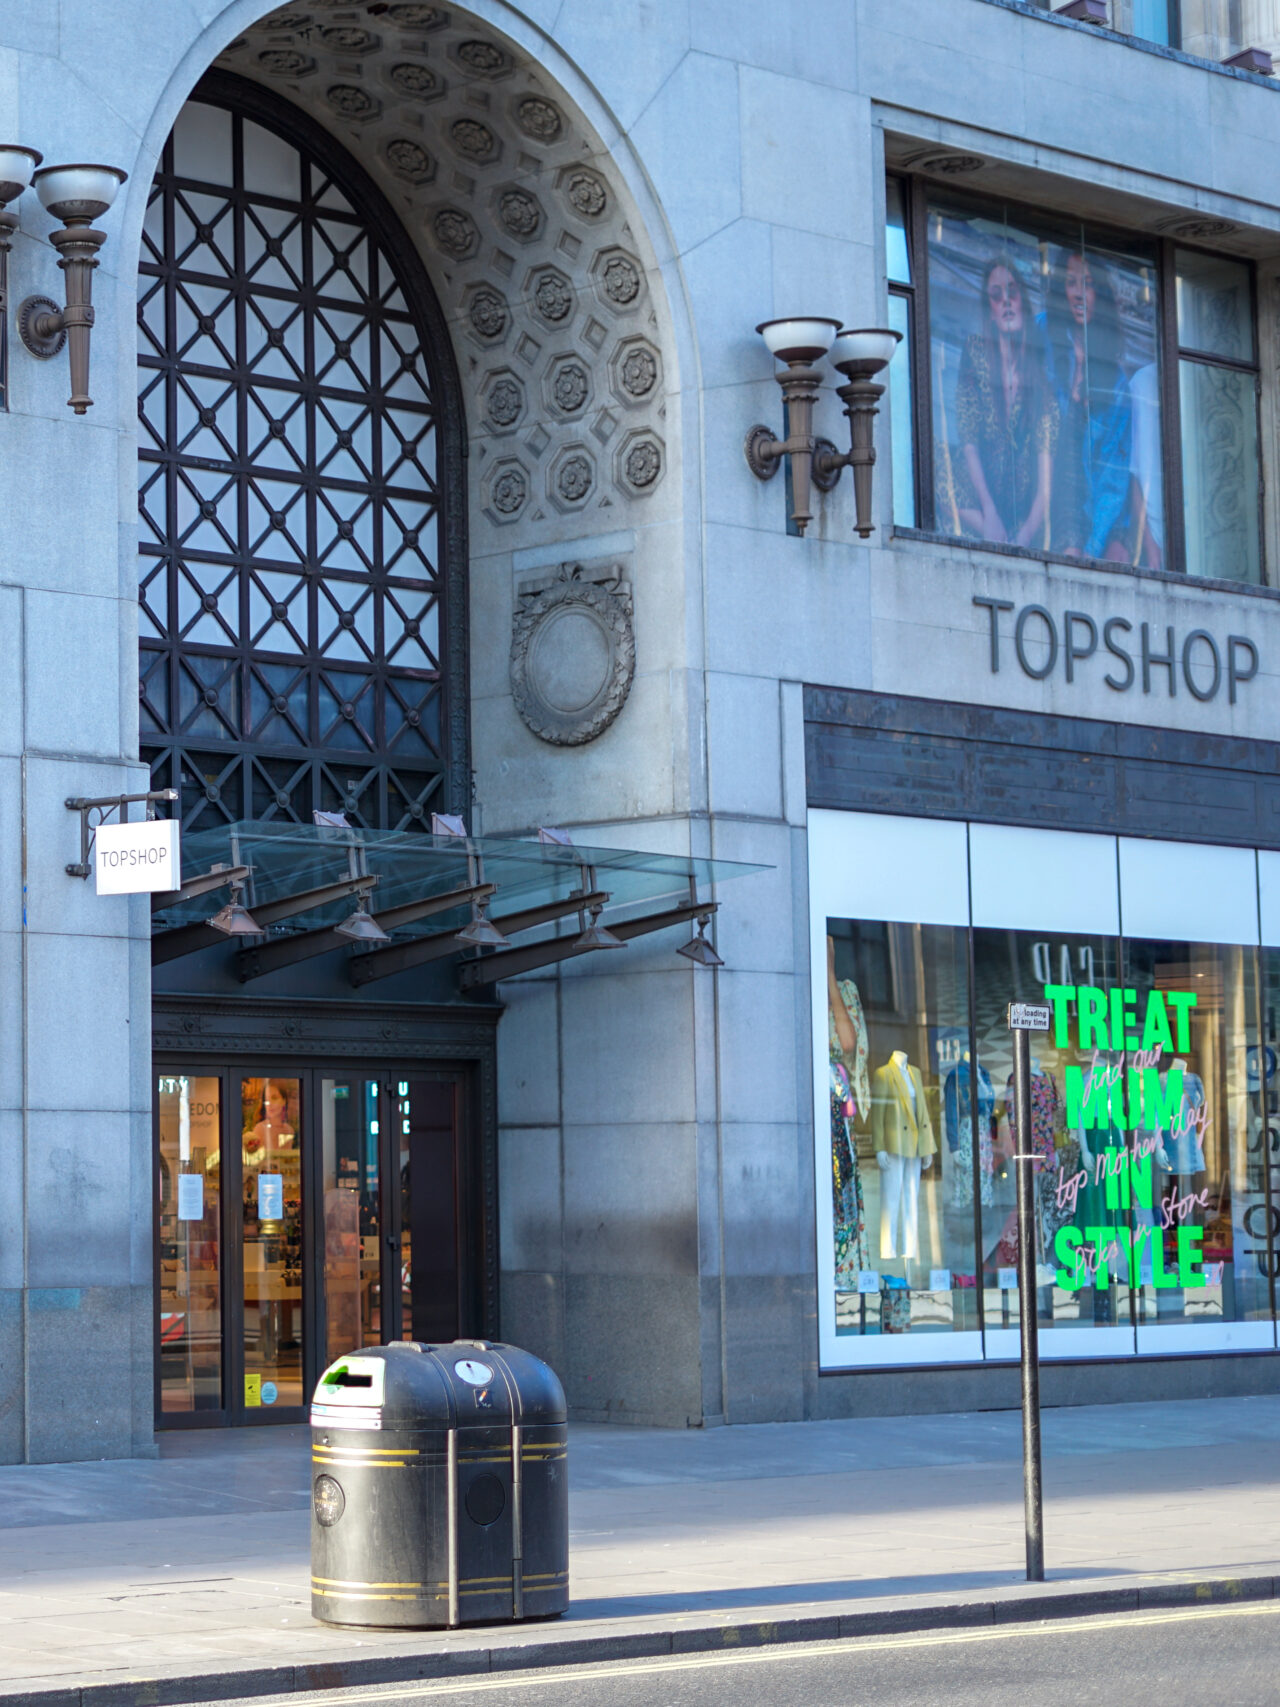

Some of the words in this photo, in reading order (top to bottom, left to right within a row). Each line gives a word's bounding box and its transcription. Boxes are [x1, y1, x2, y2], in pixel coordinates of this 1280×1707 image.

[973, 597, 1260, 704] TOPSHOP
[100, 847, 167, 867] TOPSHOP
[1044, 984, 1197, 1053] TREAT
[1065, 1066, 1185, 1130] MUM
[1104, 1146, 1153, 1210] IN
[1160, 1186, 1210, 1230] store
[1054, 1225, 1207, 1292] STYLE
